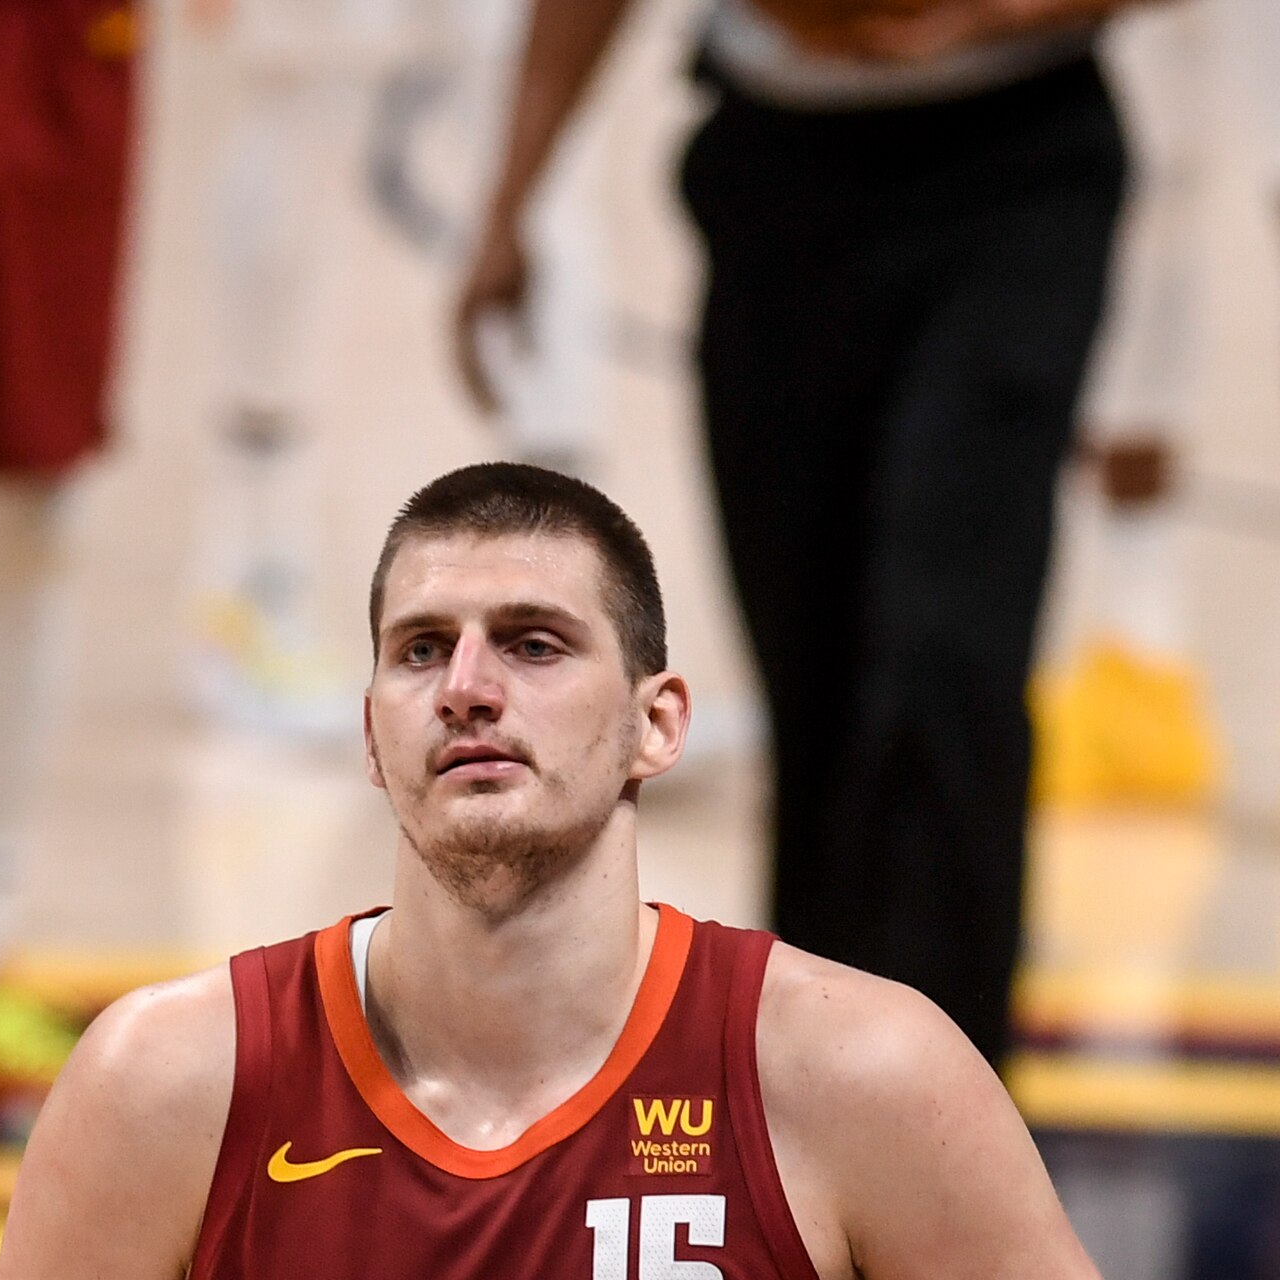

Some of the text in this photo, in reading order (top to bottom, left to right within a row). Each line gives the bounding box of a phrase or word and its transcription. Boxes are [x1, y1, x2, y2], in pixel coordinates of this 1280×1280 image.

[633, 1098, 713, 1136] WU
[631, 1140, 711, 1156] Western
[644, 1156, 697, 1174] Union
